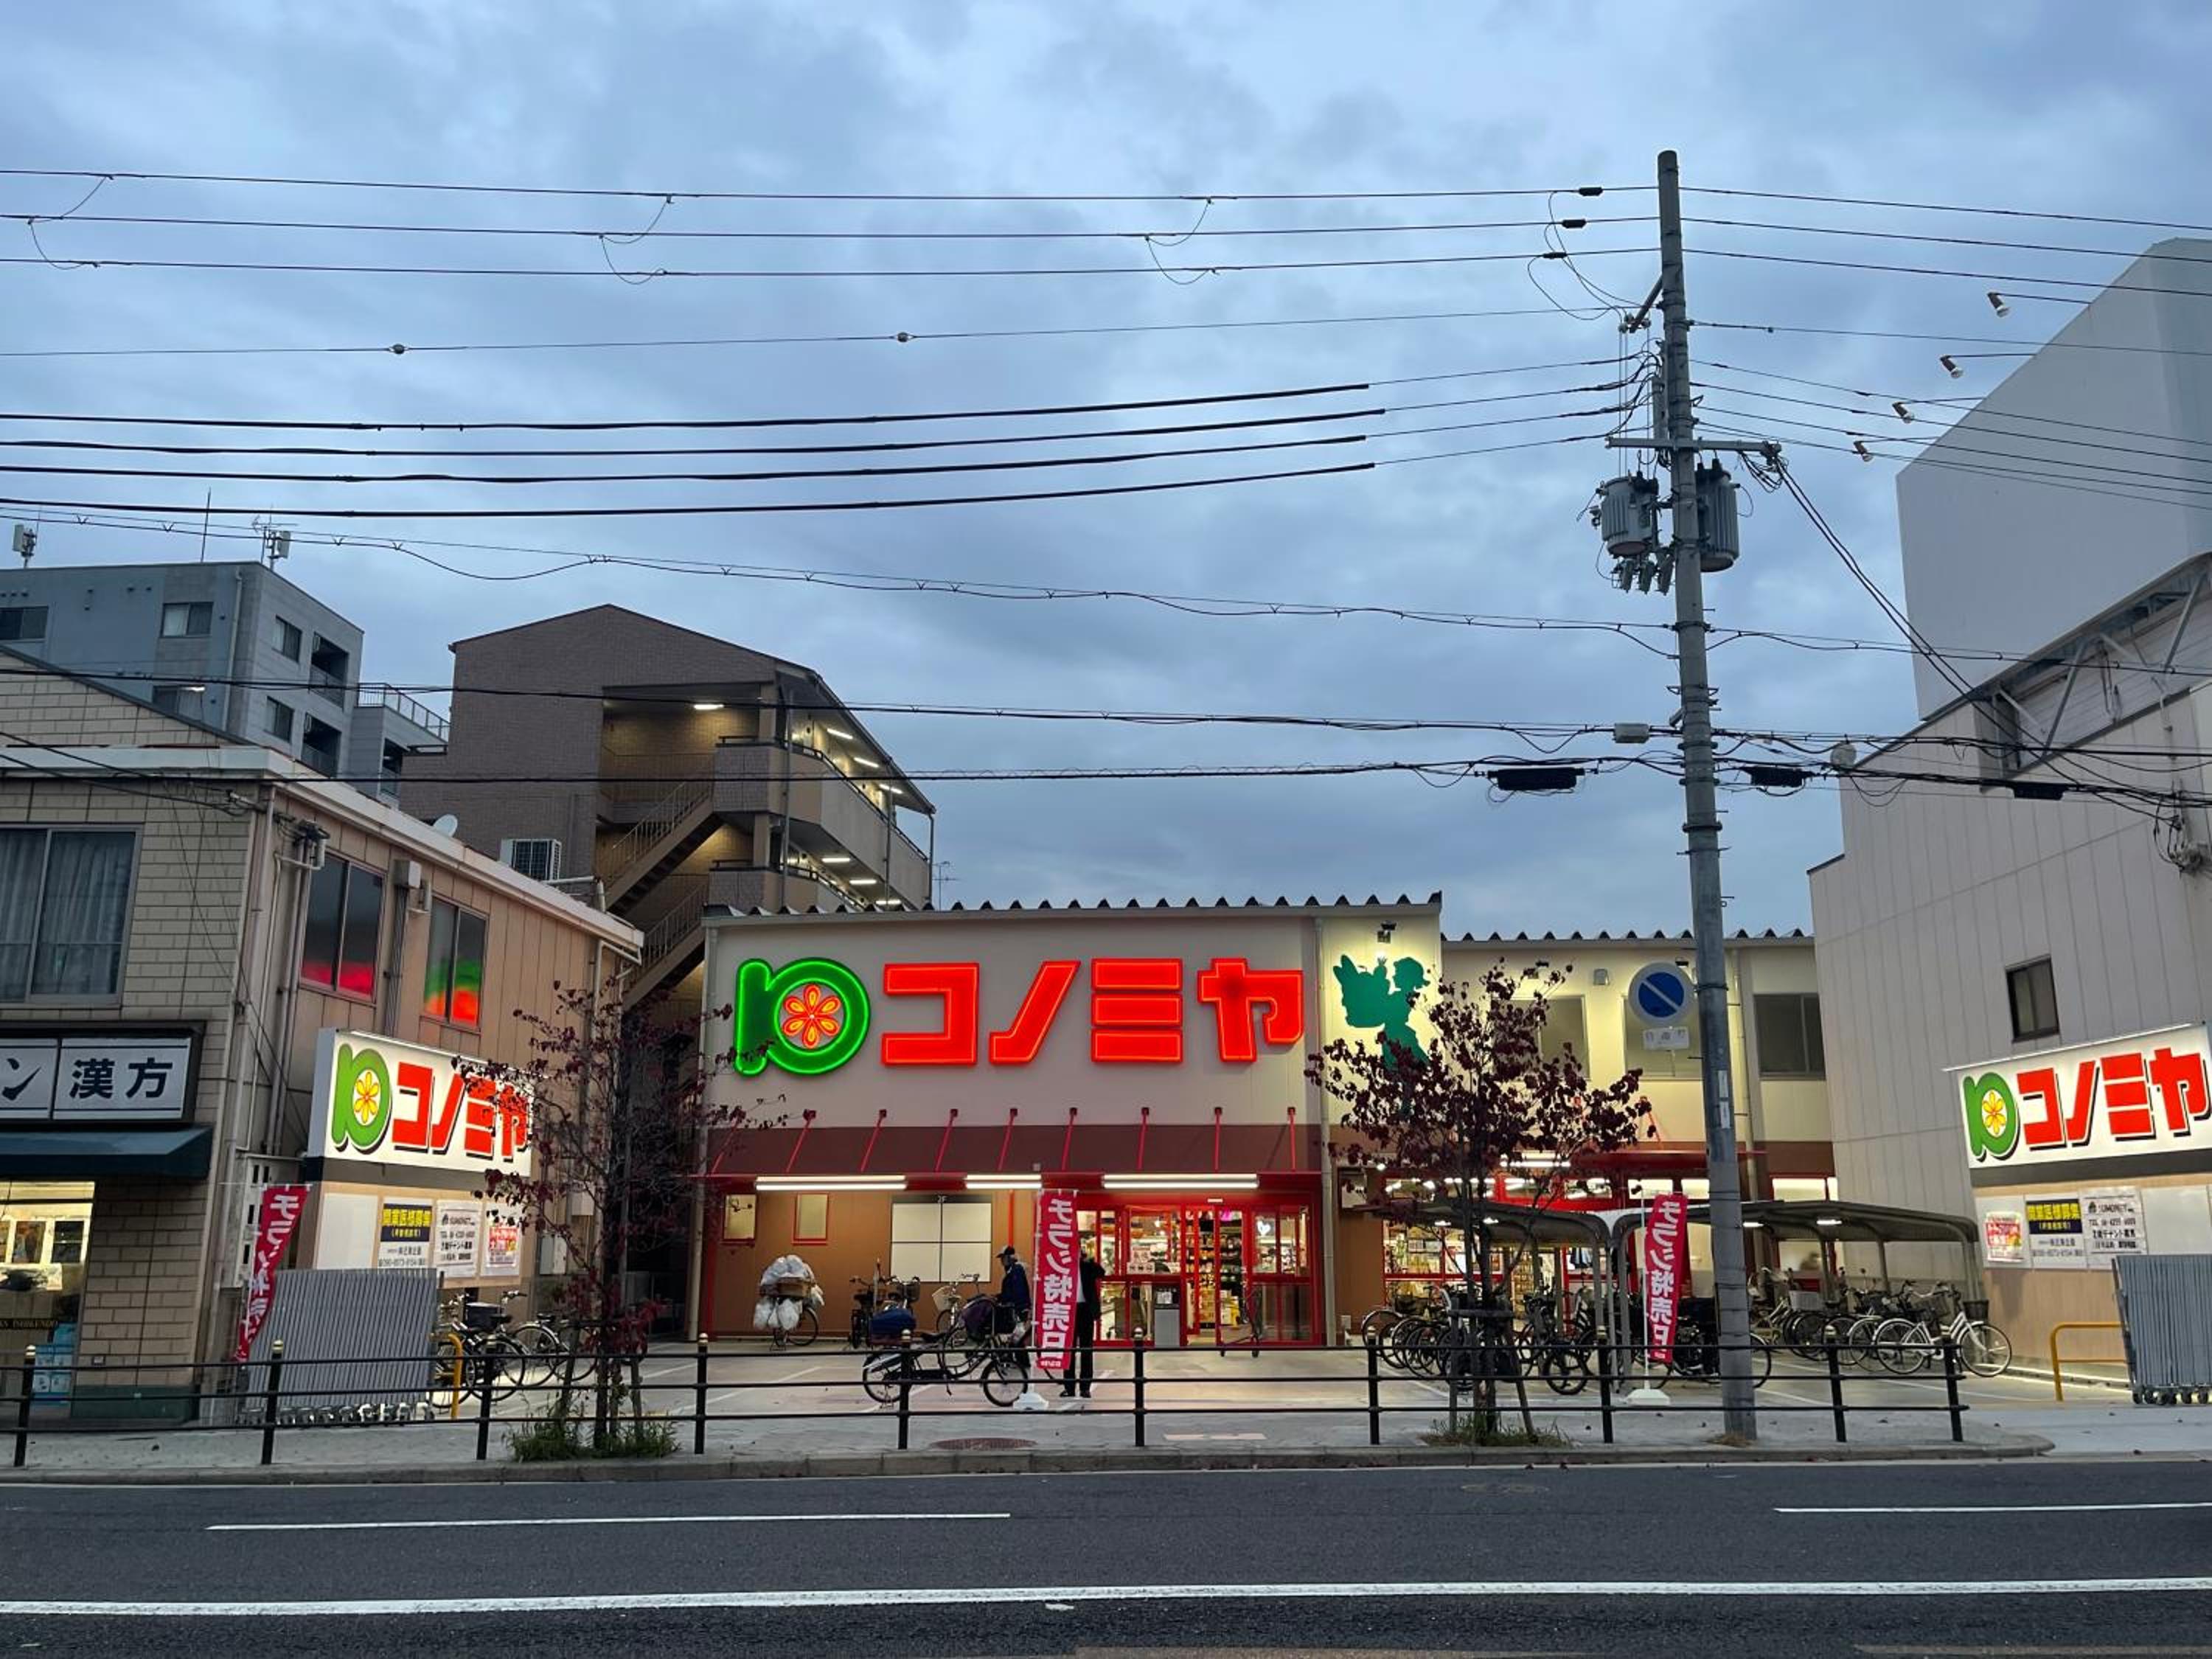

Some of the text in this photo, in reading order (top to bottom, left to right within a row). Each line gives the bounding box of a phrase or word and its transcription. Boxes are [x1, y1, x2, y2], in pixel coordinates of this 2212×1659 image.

[881, 958, 1304, 1066] コノミヤ
[69, 1057, 173, 1099] 漢方
[392, 1062, 531, 1162] コノミヤ
[2017, 1048, 2211, 1150] コノミヤ
